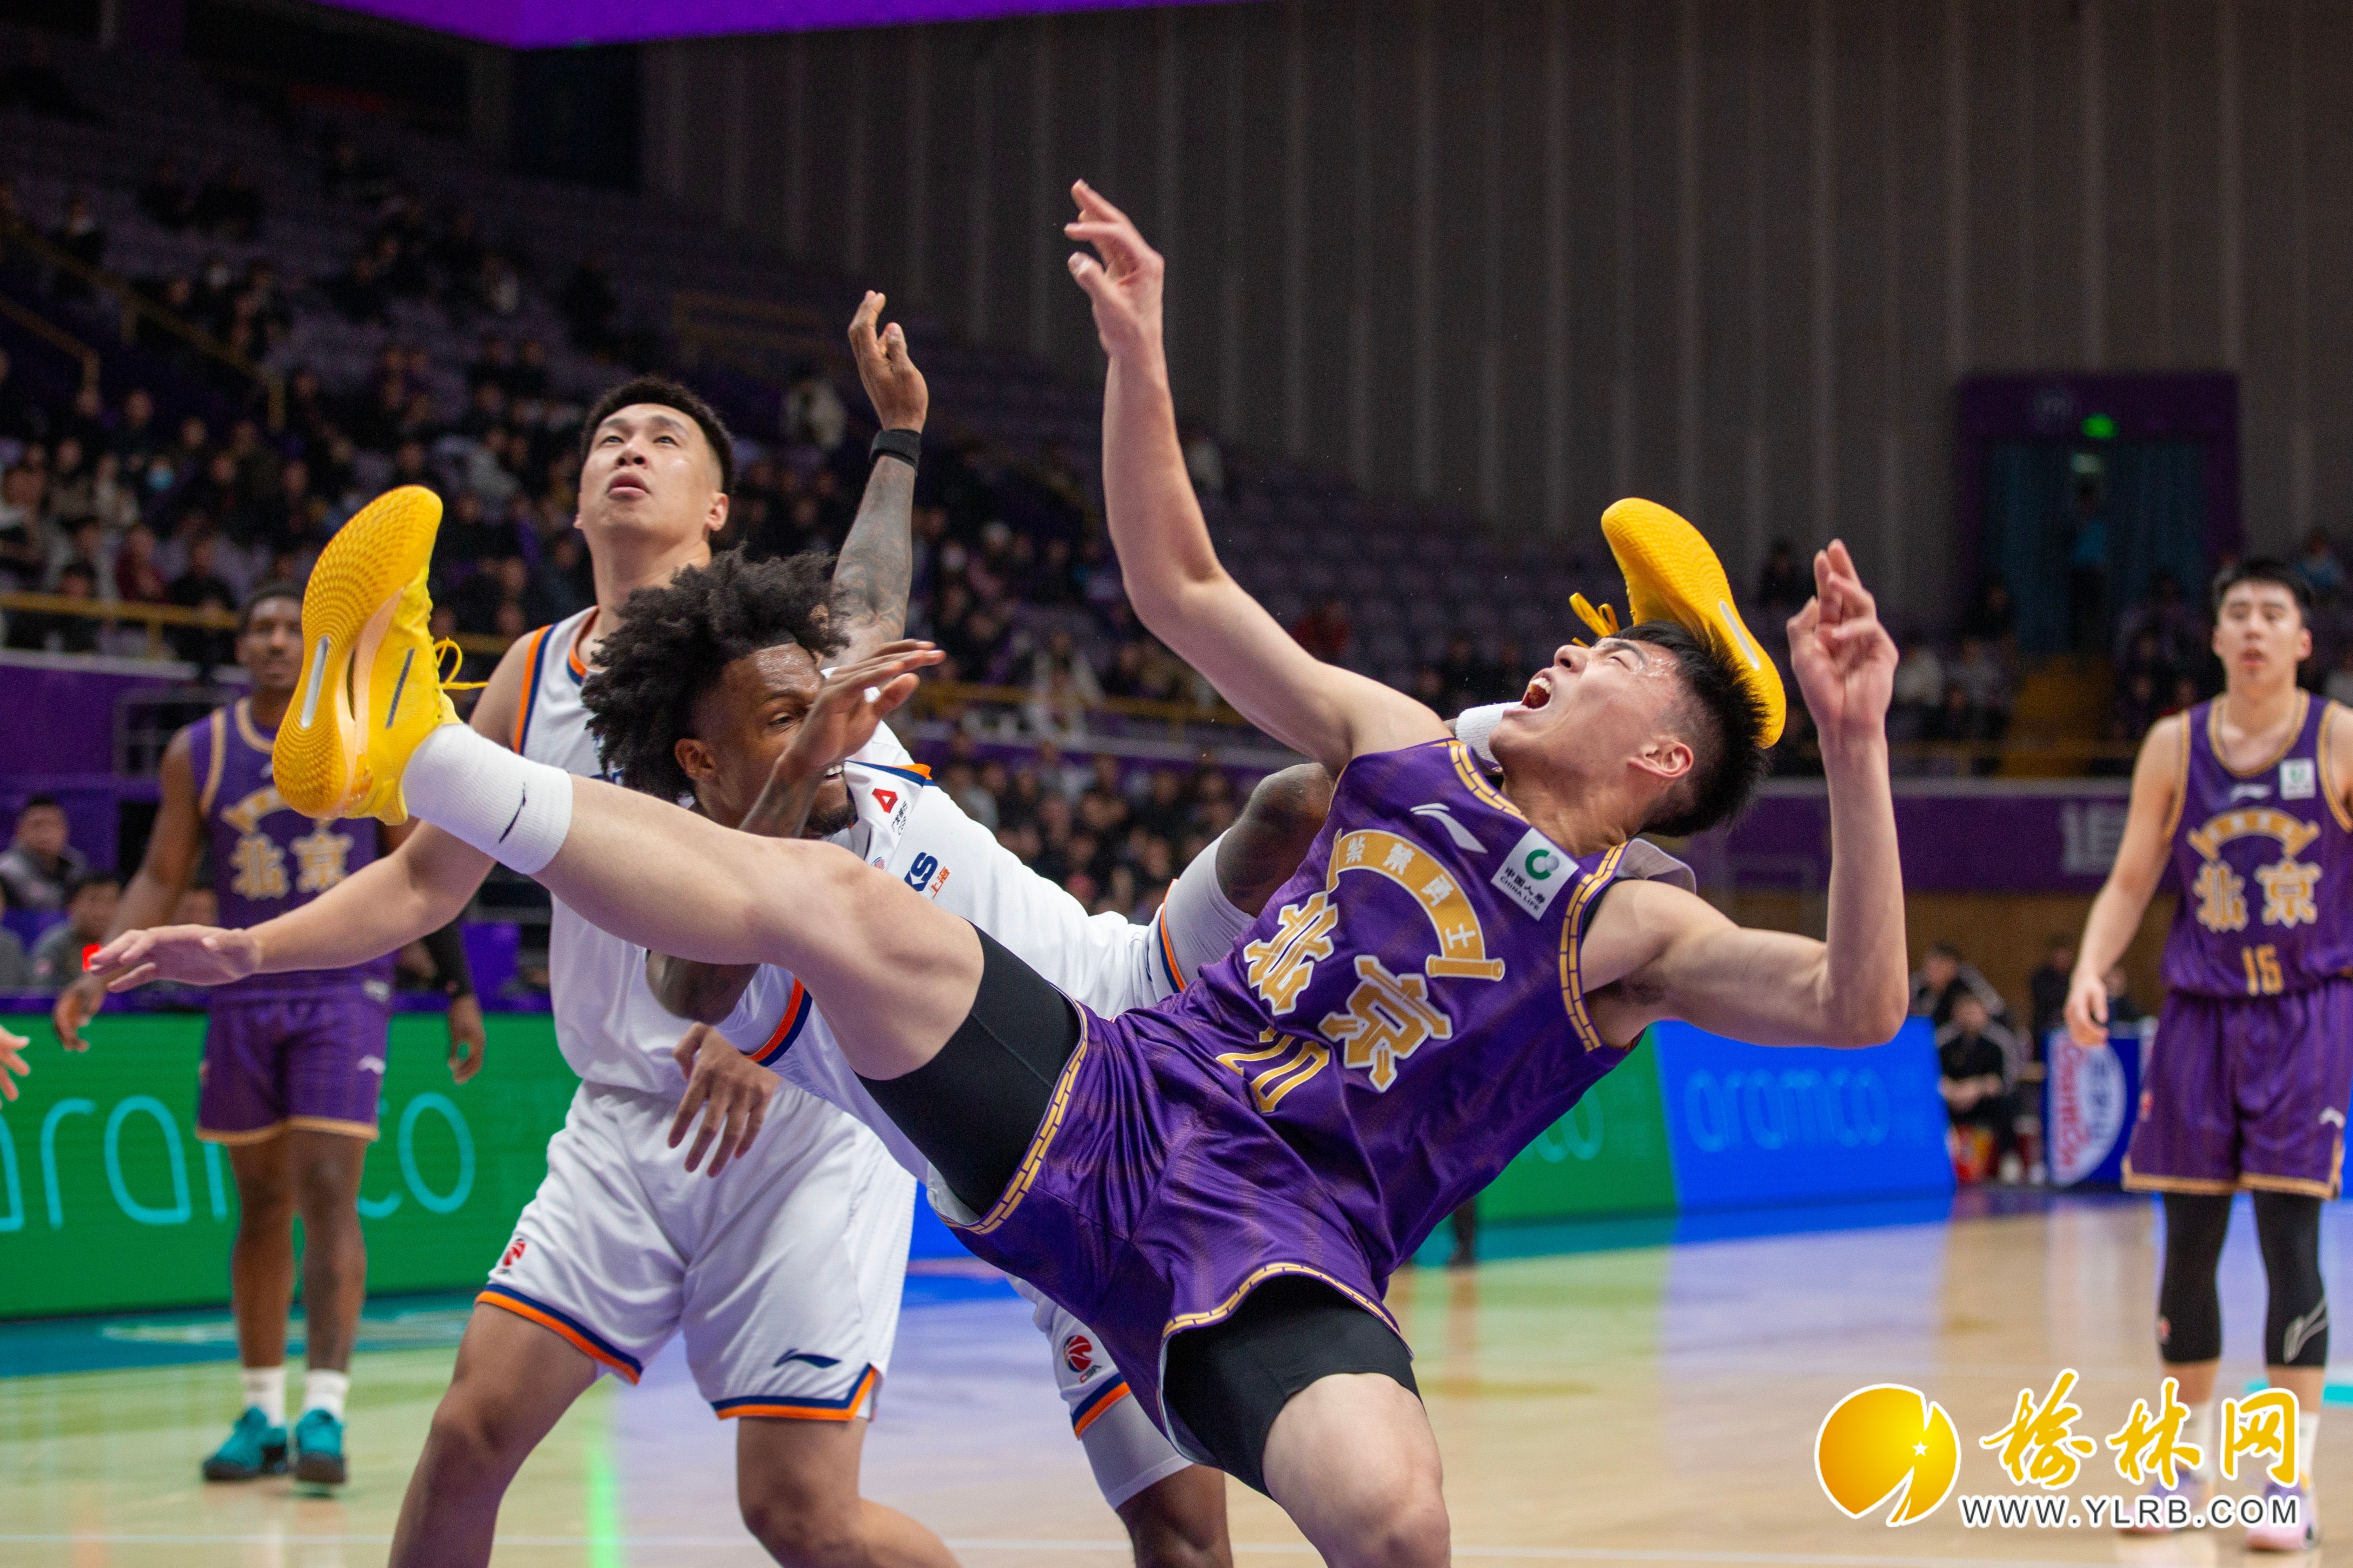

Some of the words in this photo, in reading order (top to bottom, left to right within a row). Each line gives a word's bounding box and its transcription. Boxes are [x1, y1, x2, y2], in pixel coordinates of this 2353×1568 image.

[229, 832, 354, 899] 北京
[931, 866, 951, 899] 上海
[1500, 876, 1522, 898] CHINA
[1523, 895, 1540, 912] LIFE
[2192, 860, 2323, 933] 北京
[1244, 891, 1453, 1093] 北京
[1684, 1068, 1891, 1152] aramco
